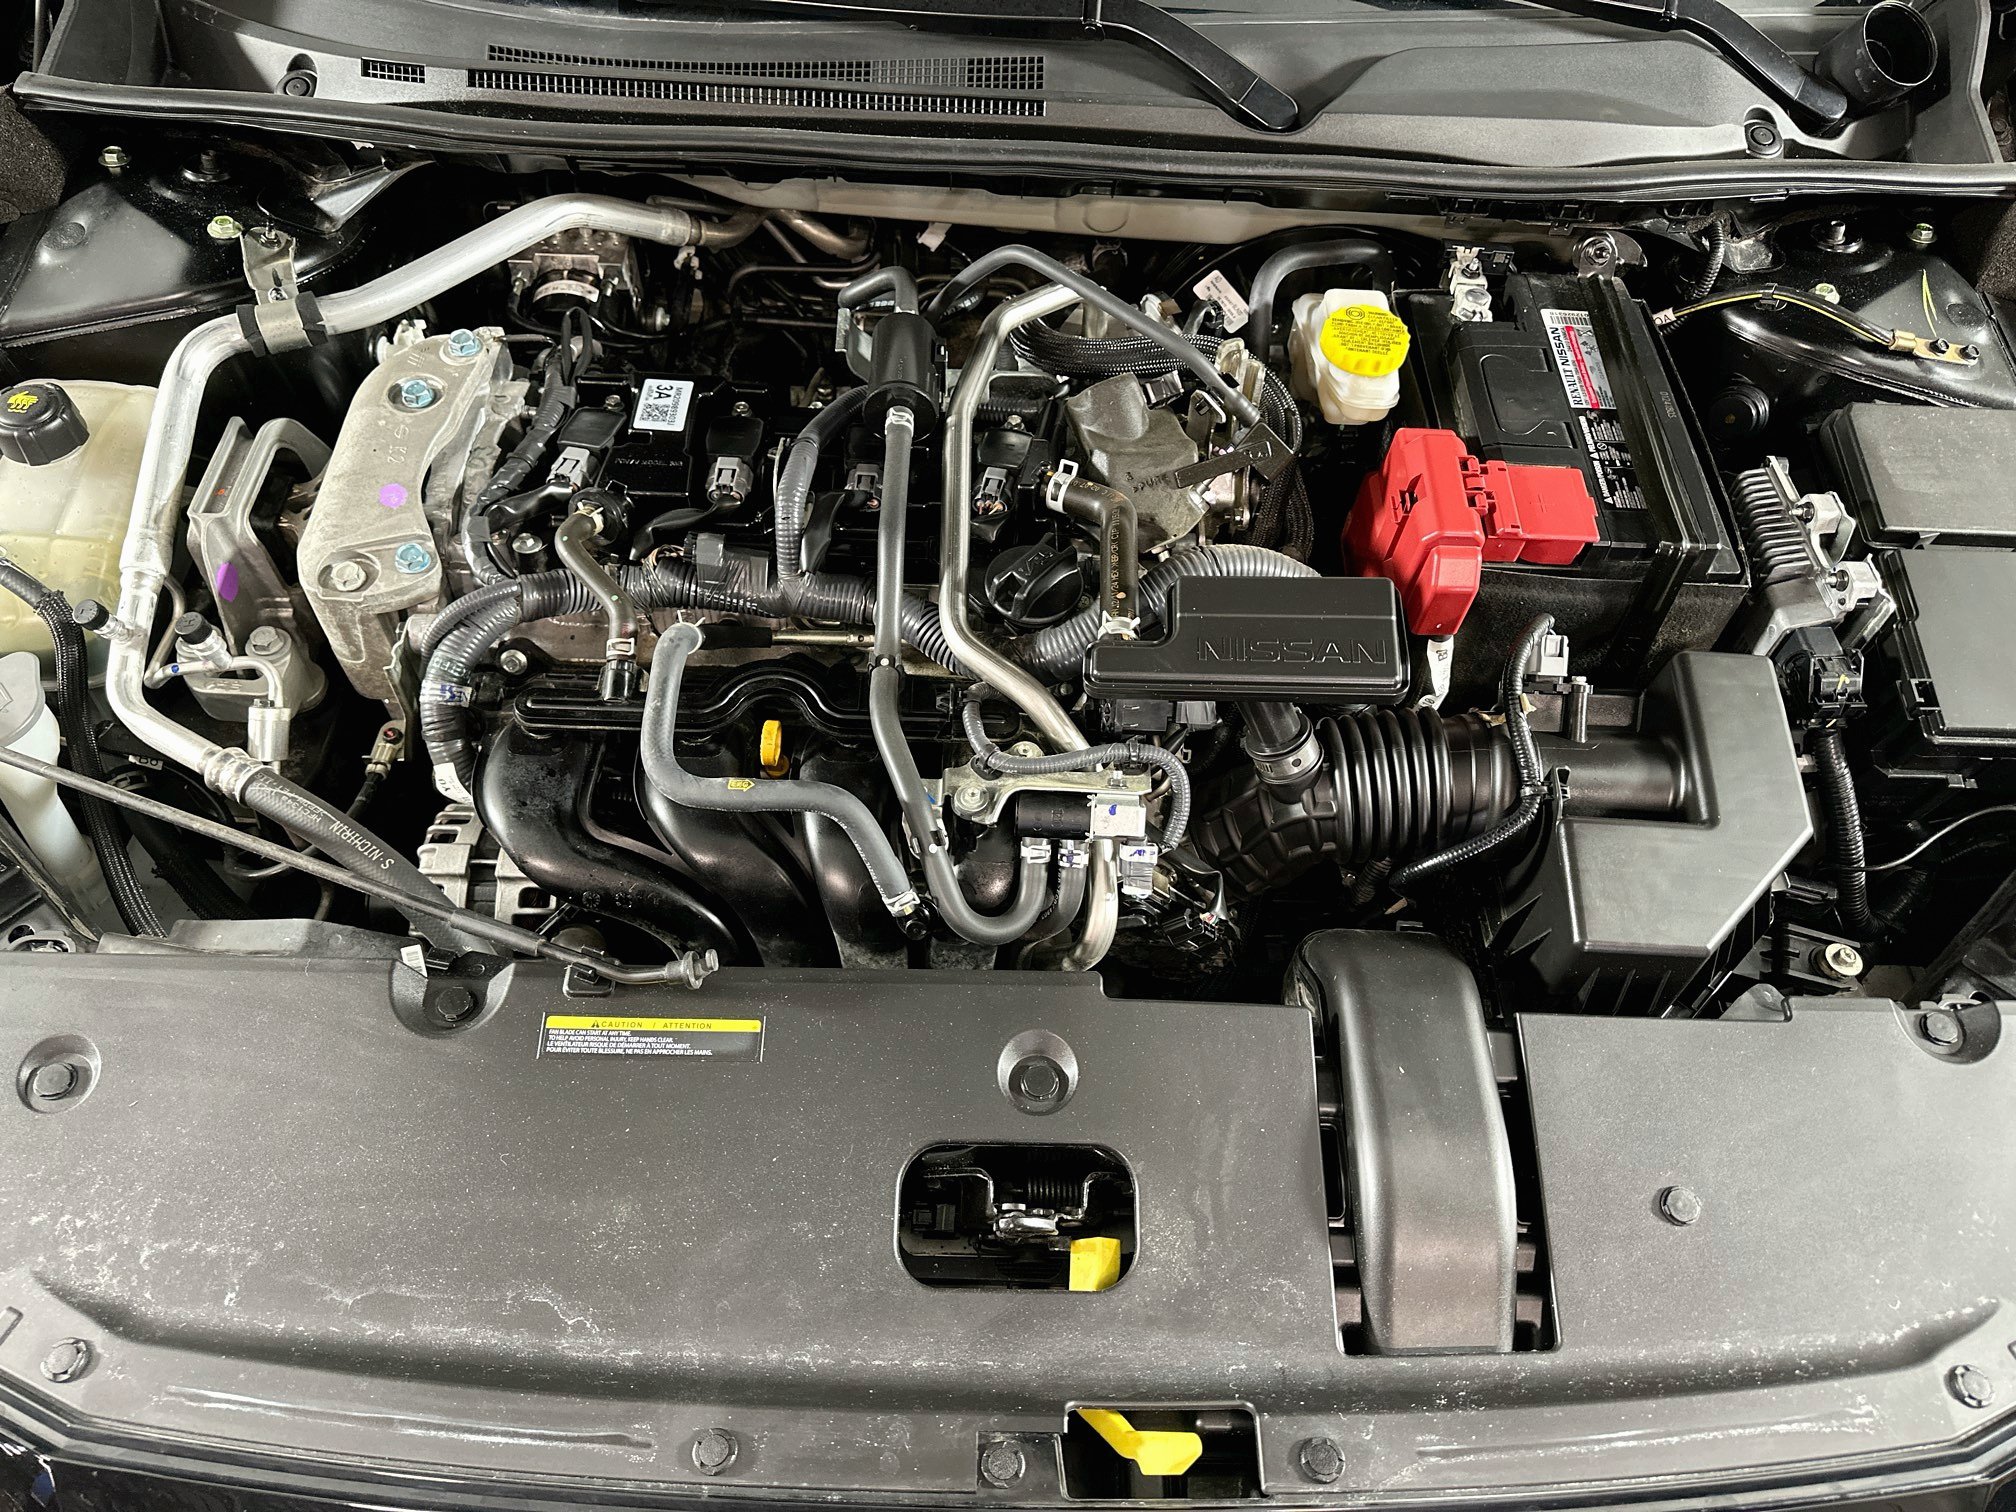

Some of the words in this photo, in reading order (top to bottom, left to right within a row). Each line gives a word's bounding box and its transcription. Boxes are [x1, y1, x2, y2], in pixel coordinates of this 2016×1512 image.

[1549, 326, 1571, 366] NISSAN
[653, 384, 674, 400] 3A
[1563, 368, 1584, 406] RENAULT
[1197, 637, 1387, 664] NISSAN
[662, 1022, 712, 1030] ATTENTION
